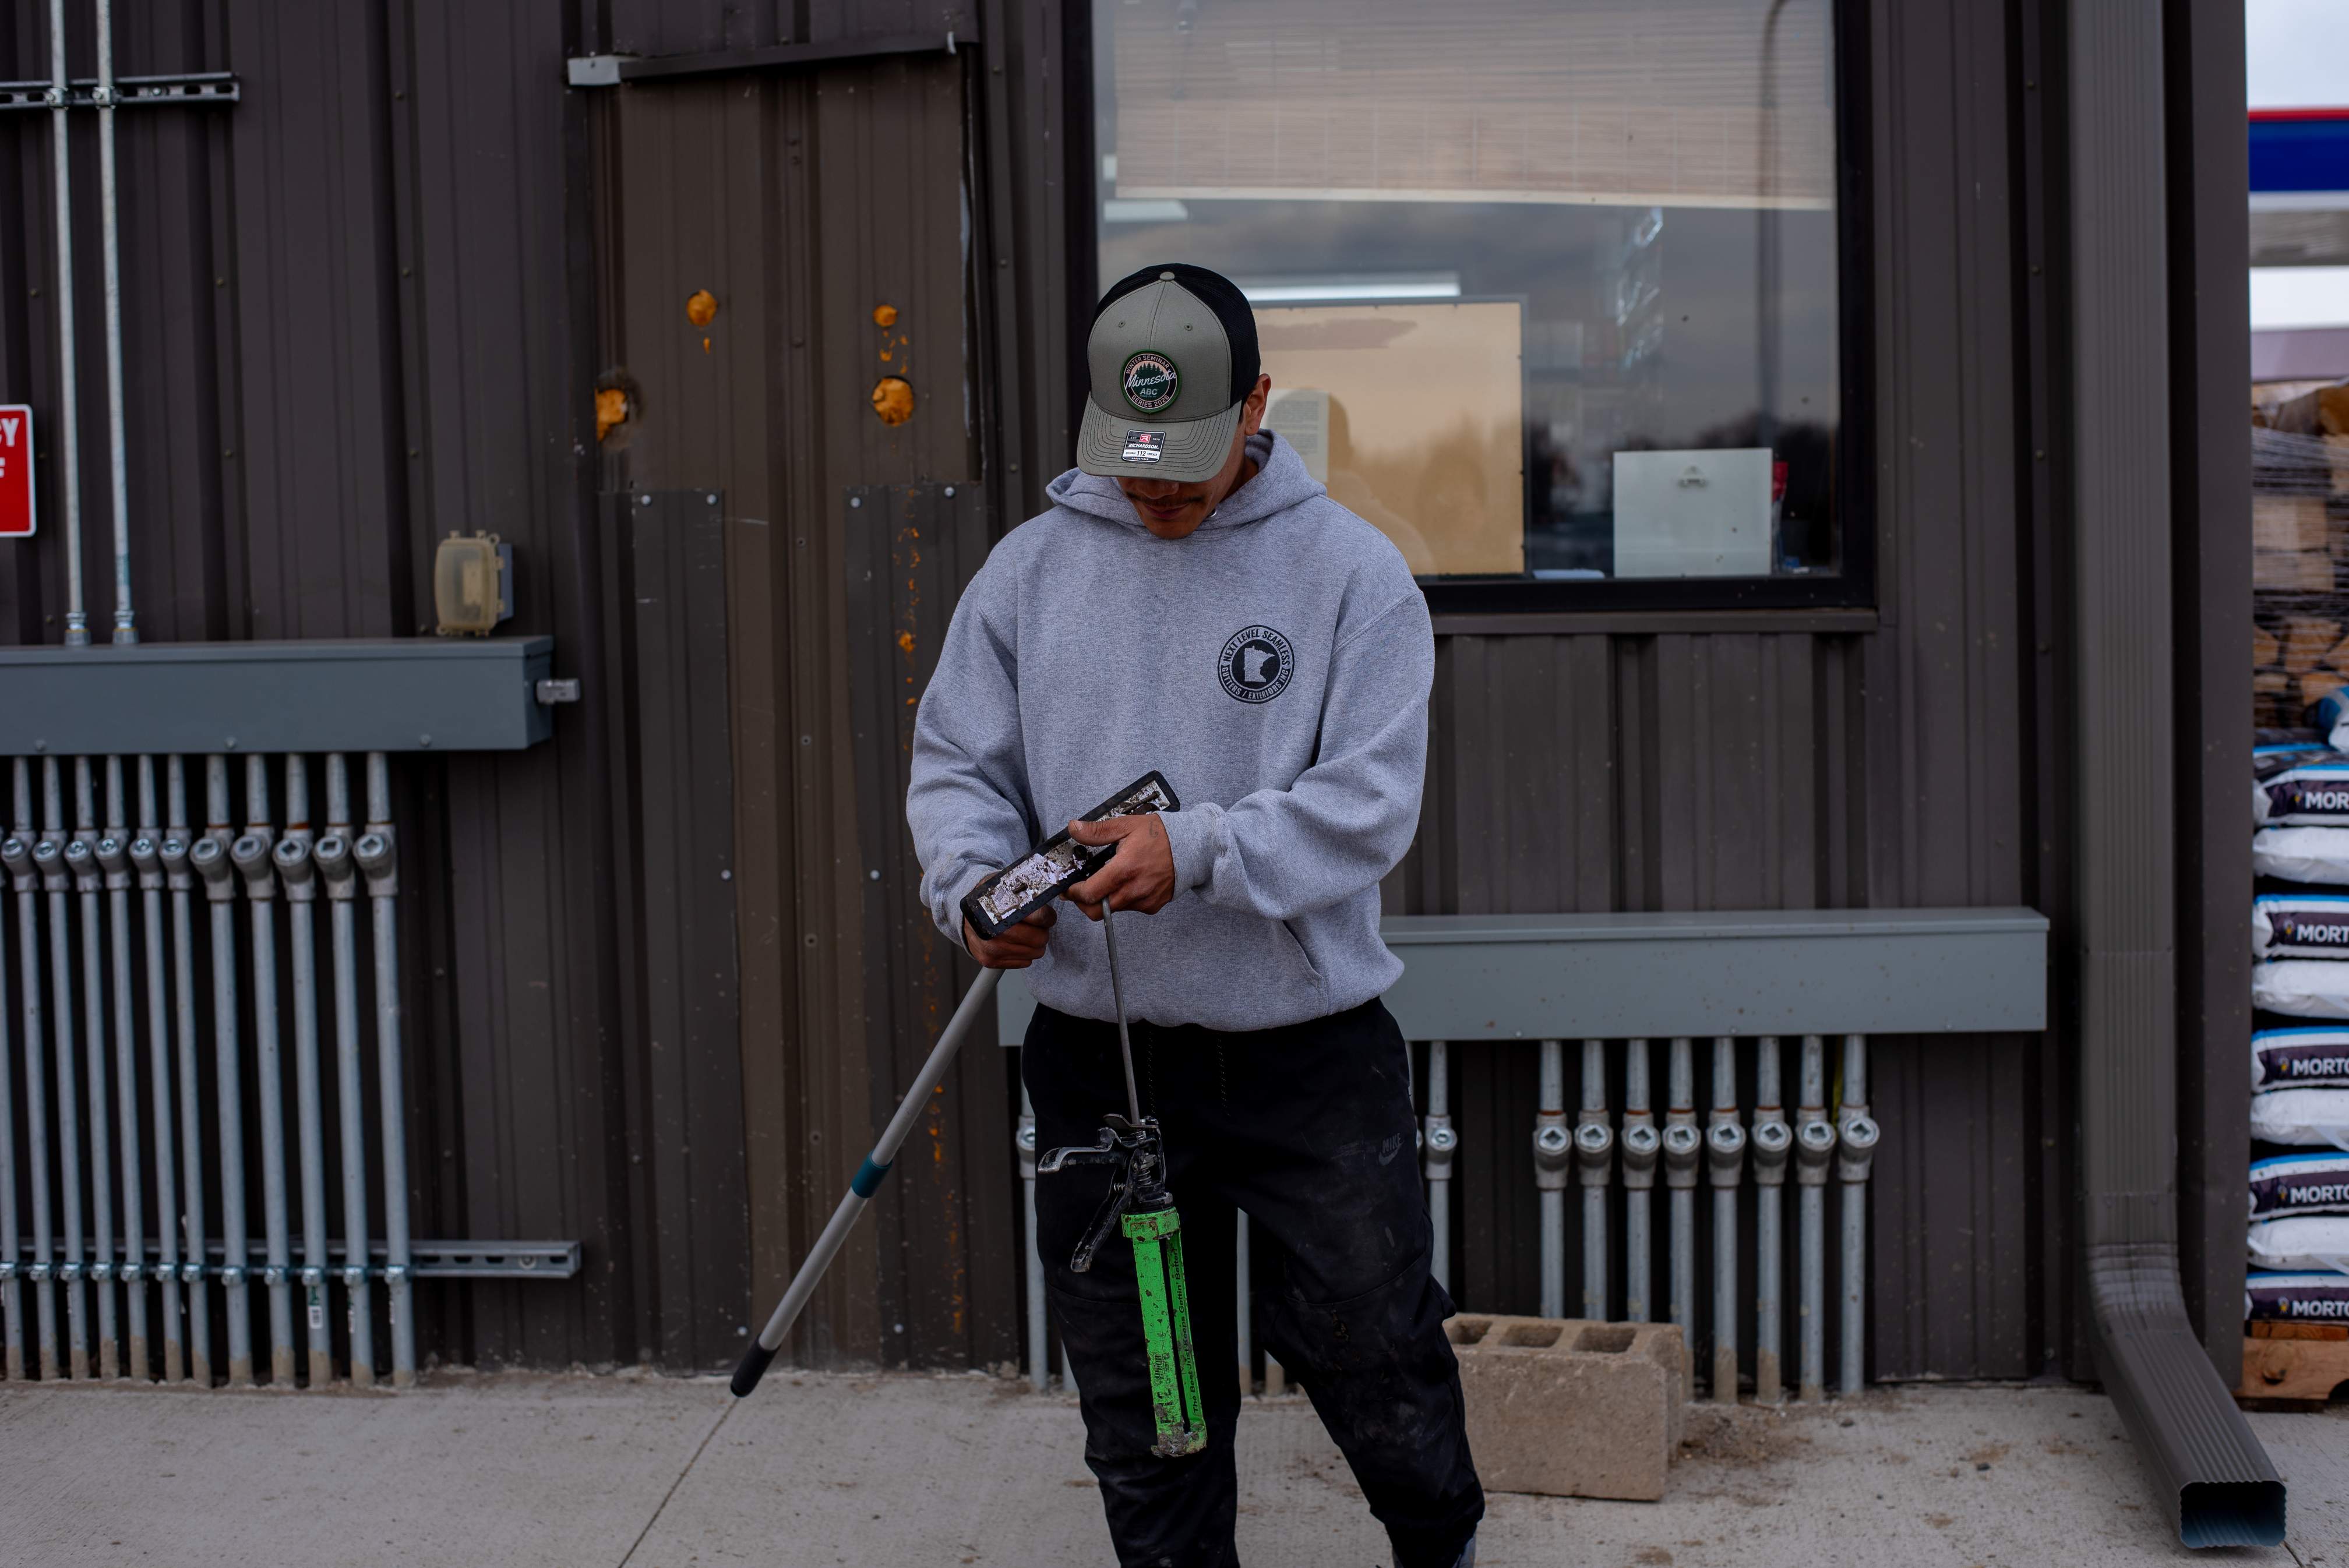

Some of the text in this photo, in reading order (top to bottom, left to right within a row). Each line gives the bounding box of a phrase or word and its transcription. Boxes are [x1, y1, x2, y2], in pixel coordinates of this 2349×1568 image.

[1126, 355, 1170, 374] WINTER SEMINAR
[1125, 369, 1176, 390] Minnesota
[1131, 395, 1169, 408] SERIES 2026
[0, 418, 20, 447] Y
[1223, 628, 1290, 666] NEXT LEVEL SEAMLESS
[1222, 666, 1242, 695] GUTTERS
[1248, 681, 1282, 700] EXTERIORS
[1279, 669, 1289, 683] INC
[1382, 1132, 1401, 1153] NIKE
